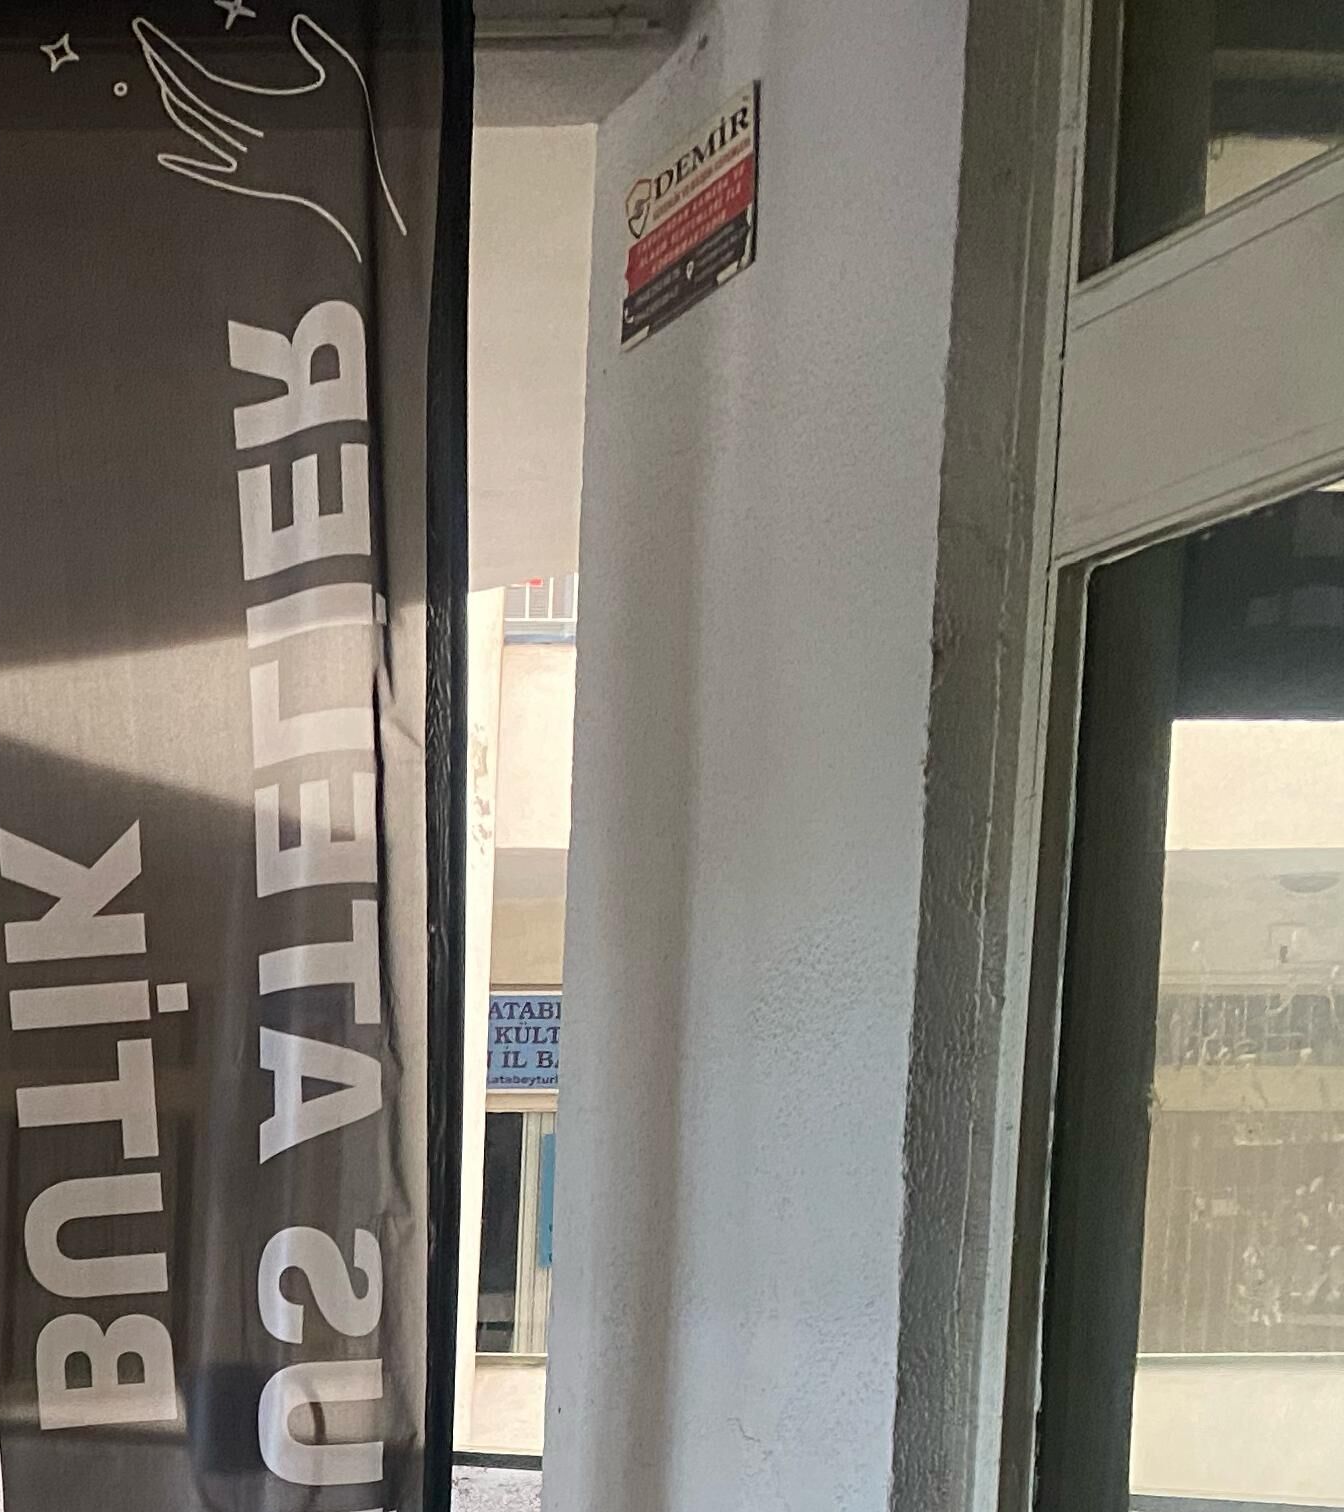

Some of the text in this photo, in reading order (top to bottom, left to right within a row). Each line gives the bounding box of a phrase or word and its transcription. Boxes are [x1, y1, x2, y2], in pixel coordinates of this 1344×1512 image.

[654, 106, 749, 199] DEMİR
[502, 1046, 527, 1068] İL
[536, 1050, 559, 1068] B
